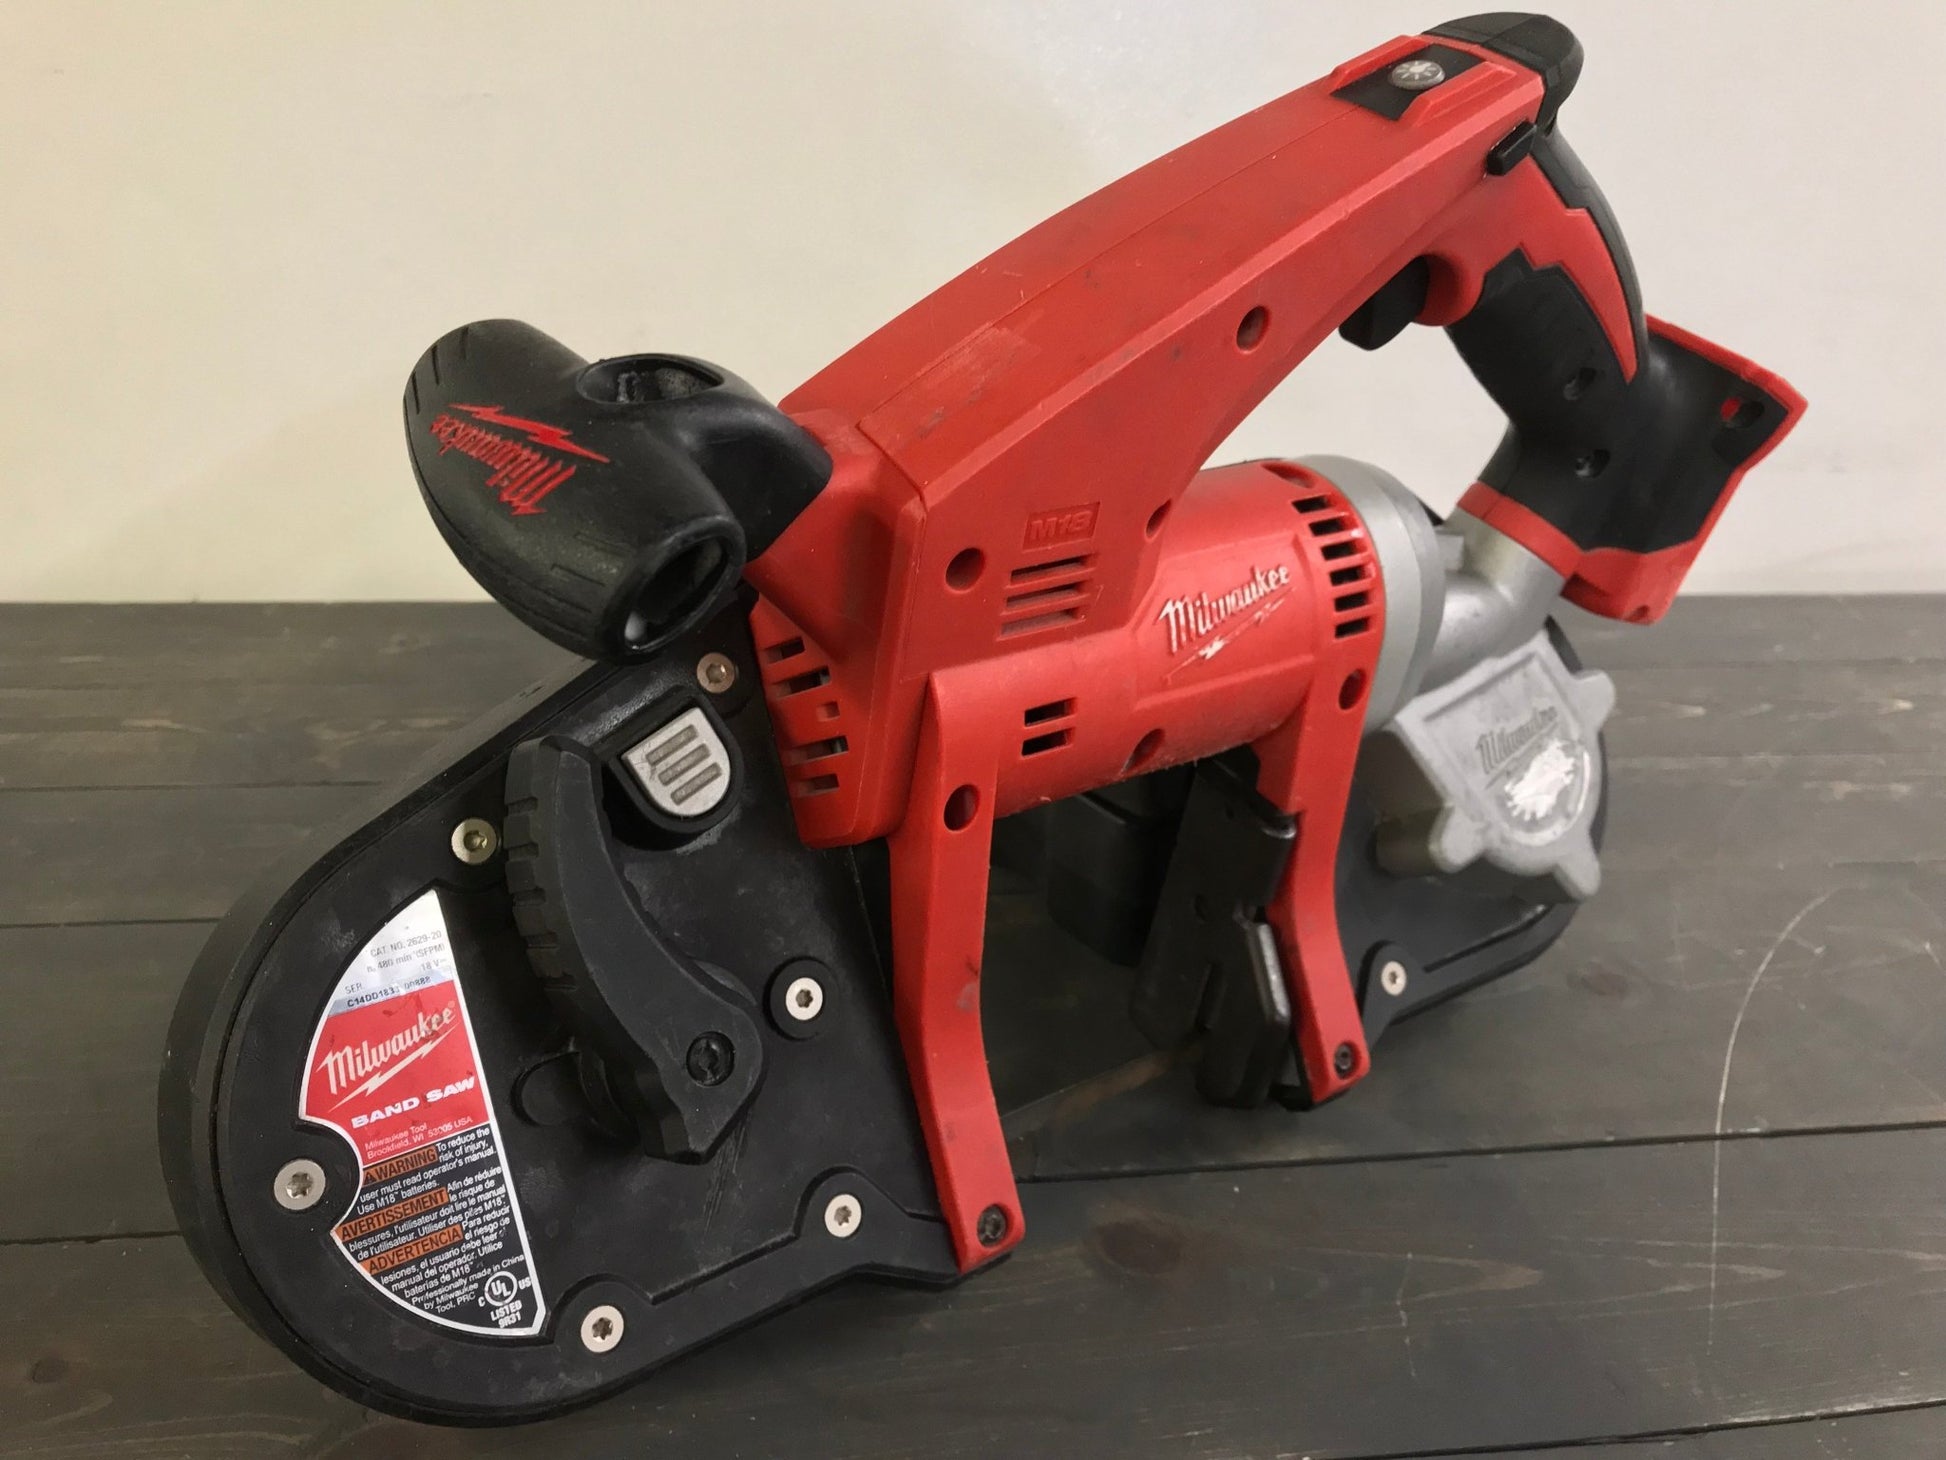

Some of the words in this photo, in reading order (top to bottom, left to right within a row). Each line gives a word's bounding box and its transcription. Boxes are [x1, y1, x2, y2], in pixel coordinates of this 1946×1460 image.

[430, 413, 577, 516] Milwaukee
[1031, 510, 1093, 541] M18
[1158, 565, 1290, 654] Milwaukee
[390, 943, 406, 953] NO.
[407, 930, 442, 948] 2629-20
[377, 959, 394, 970] 480
[421, 961, 432, 972] 18
[316, 1007, 452, 1095] Milwaukee
[352, 1097, 420, 1129] BAND
[426, 1076, 475, 1102] SAW
[364, 1130, 409, 1151] Milwaukee
[410, 1123, 428, 1135] Tool
[413, 1132, 425, 1143] WI
[454, 1116, 473, 1129] USA
[375, 1148, 436, 1180] WARNING
[436, 1142, 447, 1152] To
[447, 1132, 475, 1148] reduce
[476, 1127, 490, 1138] the
[439, 1150, 455, 1162] risk
[455, 1146, 463, 1157] of
[360, 1189, 379, 1202] user
[381, 1180, 402, 1195] must
[403, 1172, 422, 1187] read
[423, 1158, 463, 1180] operator's
[464, 1145, 496, 1164] manual.
[357, 1203, 375, 1215] Use
[401, 1180, 440, 1199] batteries.
[449, 1193, 457, 1202] le
[458, 1184, 483, 1197] risque
[484, 1179, 495, 1189] de
[341, 1190, 444, 1240] AVERTISSEMENT
[447, 1180, 462, 1192] Afin
[463, 1176, 474, 1186] de
[349, 1231, 394, 1252] blessures,
[439, 1204, 454, 1218] doit
[454, 1199, 468, 1210] lire
[468, 1195, 476, 1205] le
[357, 1250, 369, 1261] de
[418, 1219, 446, 1237] Utiliser
[448, 1213, 463, 1225] des
[465, 1230, 472, 1240] el
[473, 1222, 498, 1237] riesgo
[499, 1216, 510, 1226] de
[369, 1227, 460, 1272] ADVERTENCIA
[461, 1217, 482, 1230] Para
[483, 1205, 510, 1222] reducir
[380, 1265, 419, 1285] lesiones,
[420, 1258, 428, 1269] el
[429, 1248, 460, 1266] usuario
[461, 1239, 481, 1252] debe
[482, 1233, 498, 1245] leer
[391, 1272, 423, 1292] manual
[424, 1266, 438, 1279] del
[478, 1241, 503, 1257] Utilice
[469, 1268, 491, 1282] made
[492, 1264, 500, 1272] in
[501, 1254, 525, 1268] China
[440, 1273, 451, 1283] de
[491, 1280, 511, 1297] UL
[518, 1276, 532, 1290] US
[424, 1301, 435, 1310] by
[435, 1283, 478, 1304] Milwaukee
[456, 1292, 476, 1306] PRC
[490, 1300, 522, 1321] LISTED
[498, 1311, 522, 1329] 9R31
